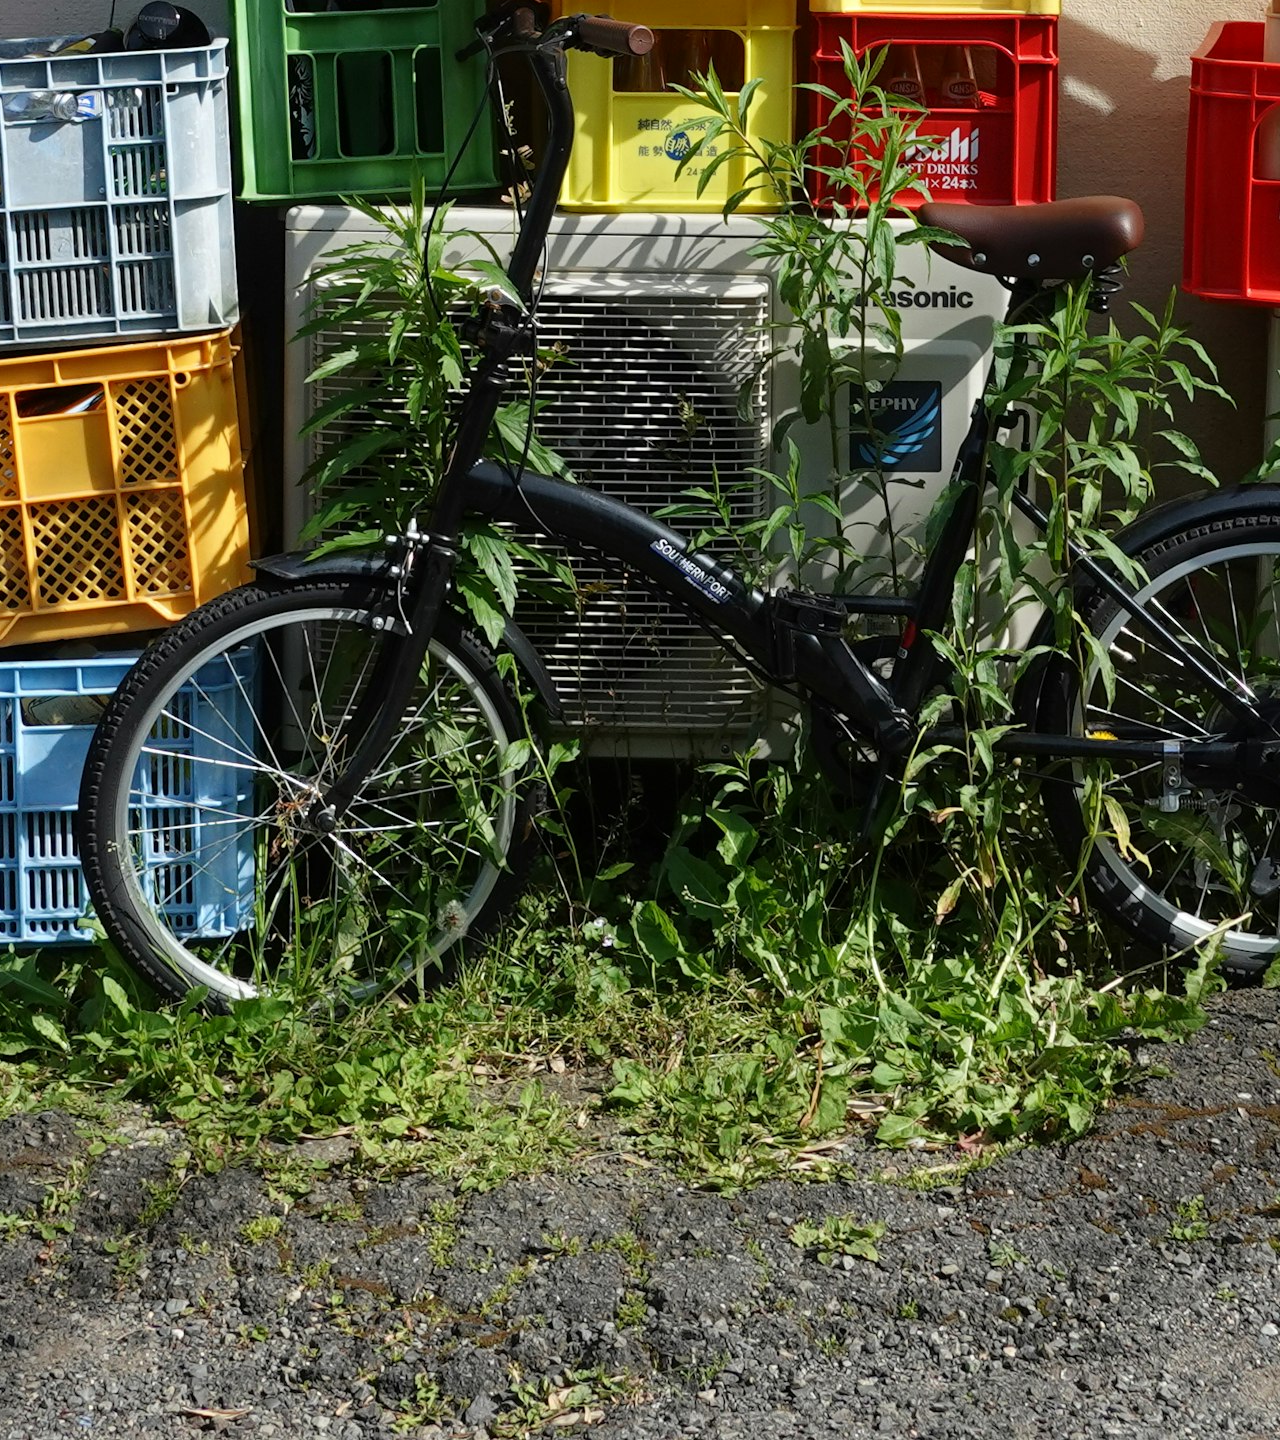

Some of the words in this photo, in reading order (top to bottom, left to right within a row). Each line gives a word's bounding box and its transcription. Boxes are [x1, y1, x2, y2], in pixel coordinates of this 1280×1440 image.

[638, 119, 672, 130] 純自然
[897, 163, 925, 175] OFT
[927, 164, 979, 175] DRINKS
